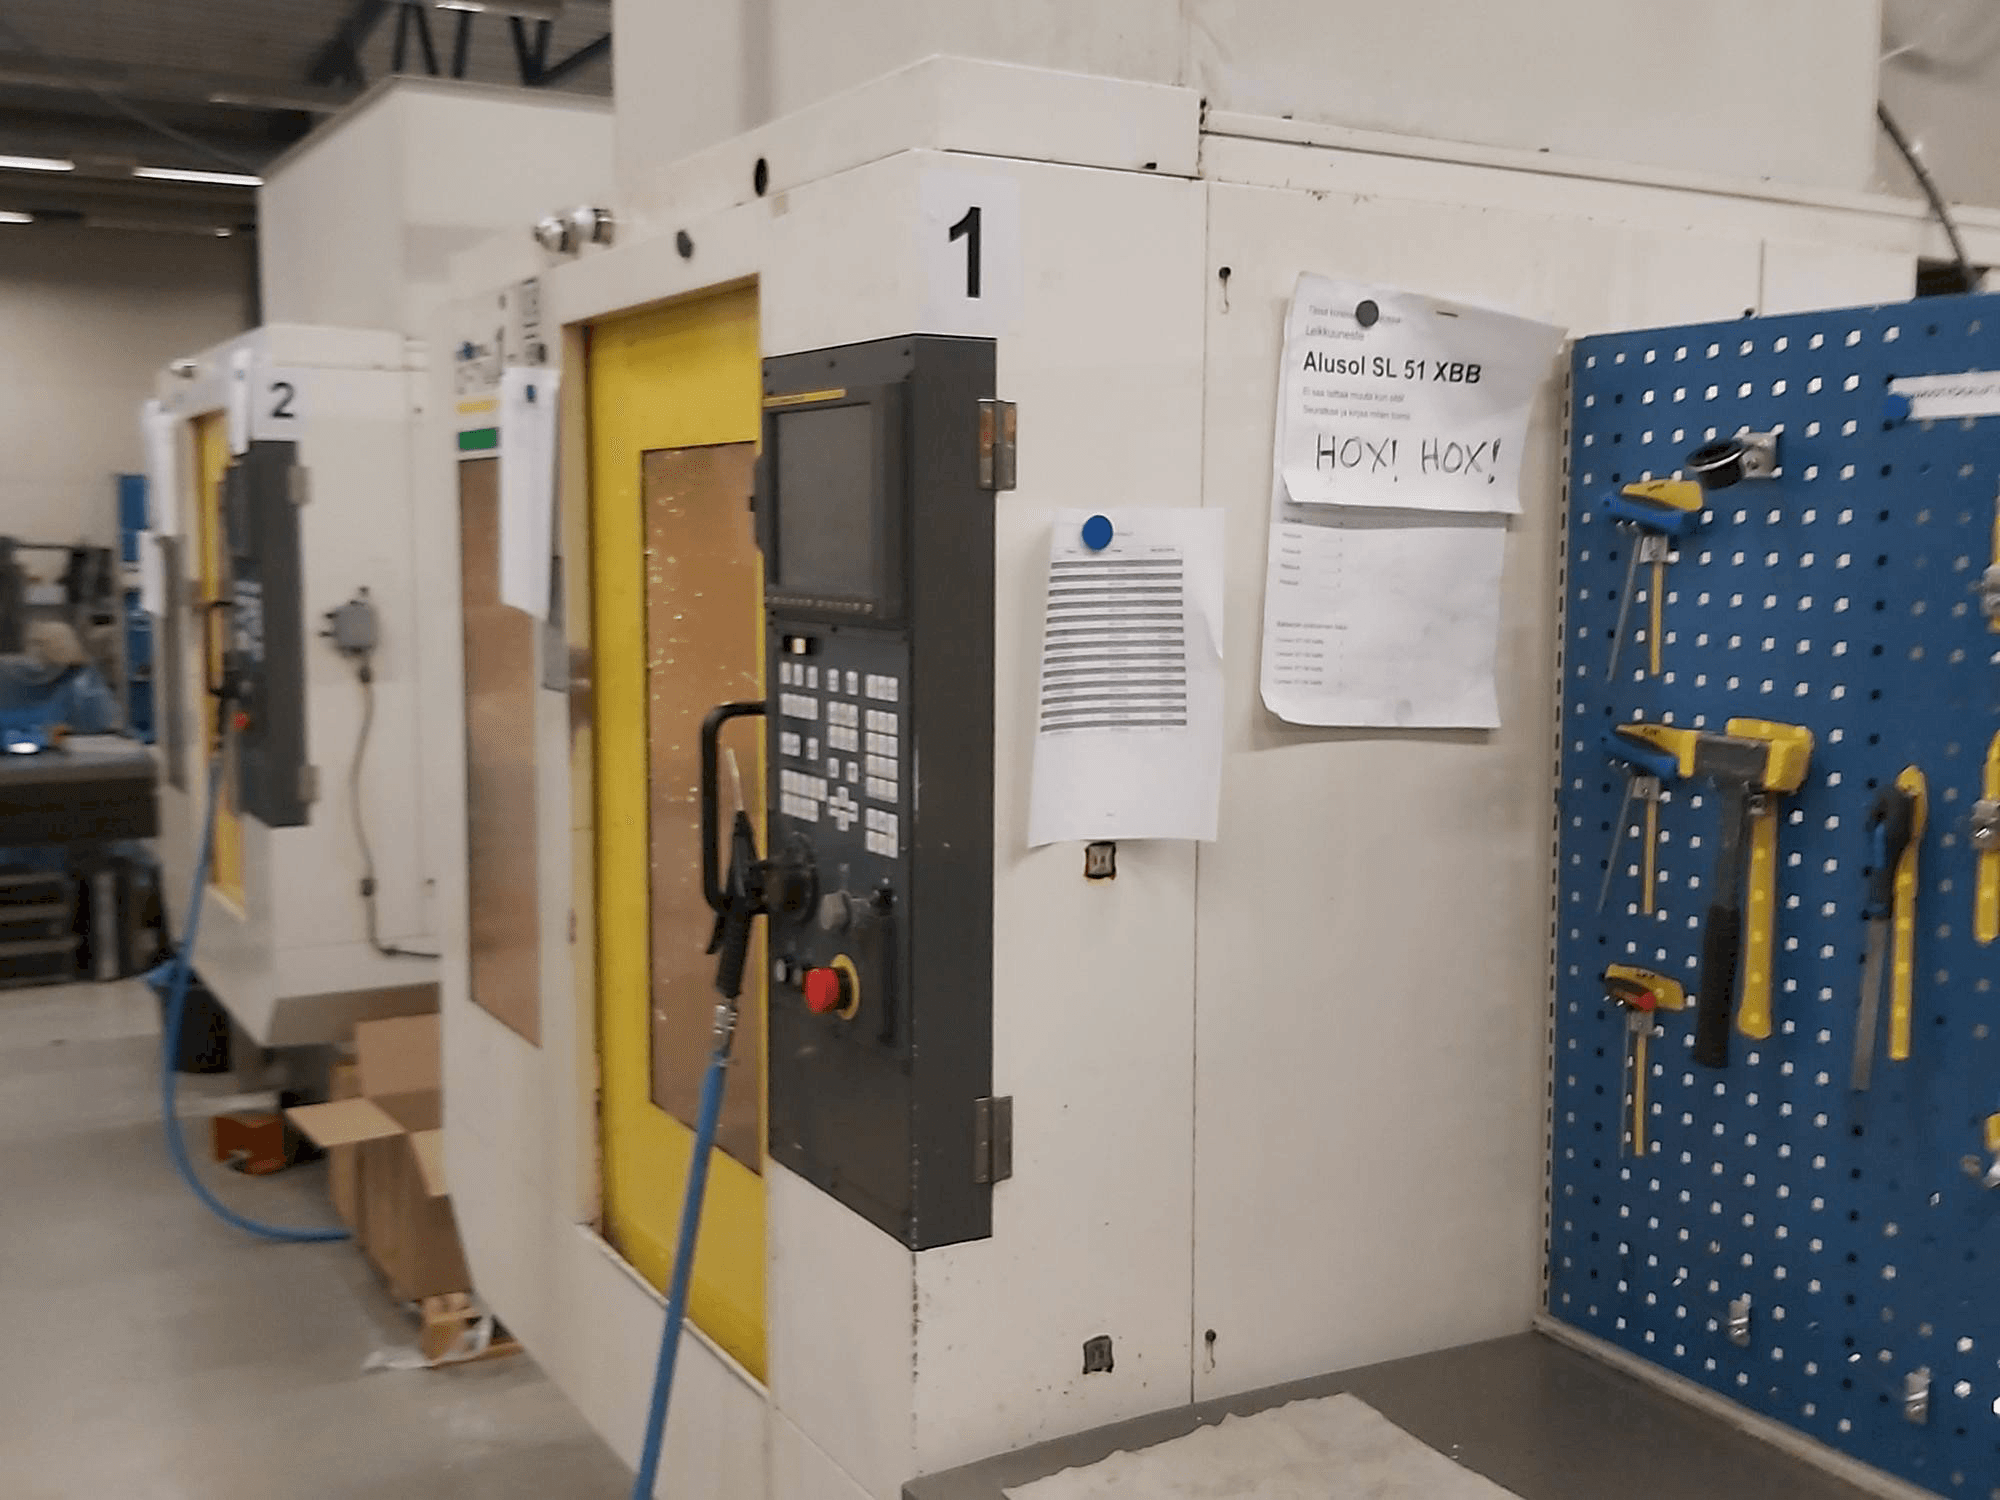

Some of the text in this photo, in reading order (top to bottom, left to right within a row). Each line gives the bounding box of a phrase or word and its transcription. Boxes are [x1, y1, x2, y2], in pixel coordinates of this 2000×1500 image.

[948, 206, 981, 299] 1
[1303, 350, 1482, 384] Alusol SL 51 XBB
[270, 382, 294, 418] 2
[1316, 433, 1501, 484] HOX! HOX!
